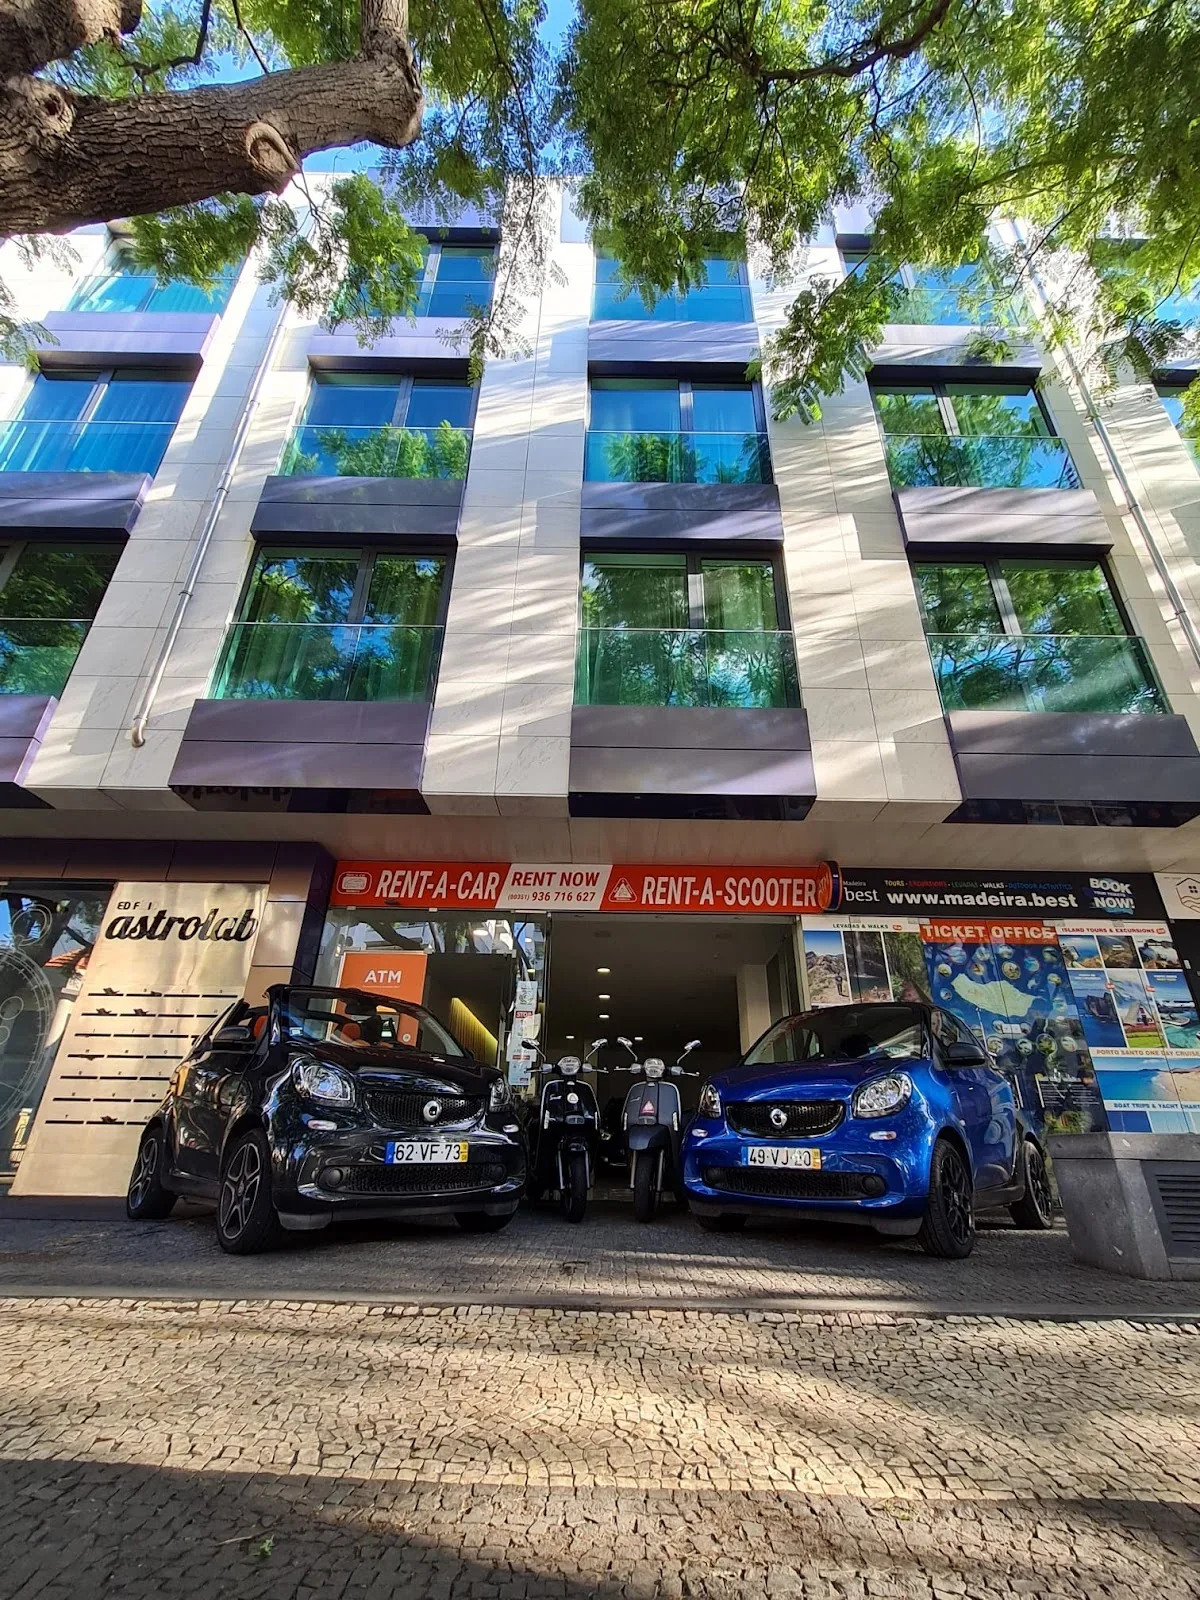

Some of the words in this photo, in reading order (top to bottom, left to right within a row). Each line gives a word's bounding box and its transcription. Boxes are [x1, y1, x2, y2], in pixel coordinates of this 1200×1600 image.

[375, 870, 500, 900] RENT-A-CAR
[511, 871, 556, 887] RENT
[559, 872, 600, 887] NOW
[982, 882, 1004, 890] WALKS
[1089, 877, 1133, 895] BOOK
[532, 892, 553, 902] 936
[554, 892, 574, 902] 716
[576, 892, 596, 902] 627
[641, 876, 817, 907] RENT-A-SCOOTER
[844, 887, 880, 902] best
[887, 891, 1079, 908] www.madeira.best
[1094, 897, 1136, 909] NOW!
[105, 908, 259, 942] astrolab
[922, 925, 986, 938] TICKET
[991, 926, 1055, 940] OFFICE
[364, 969, 402, 984] ATM
